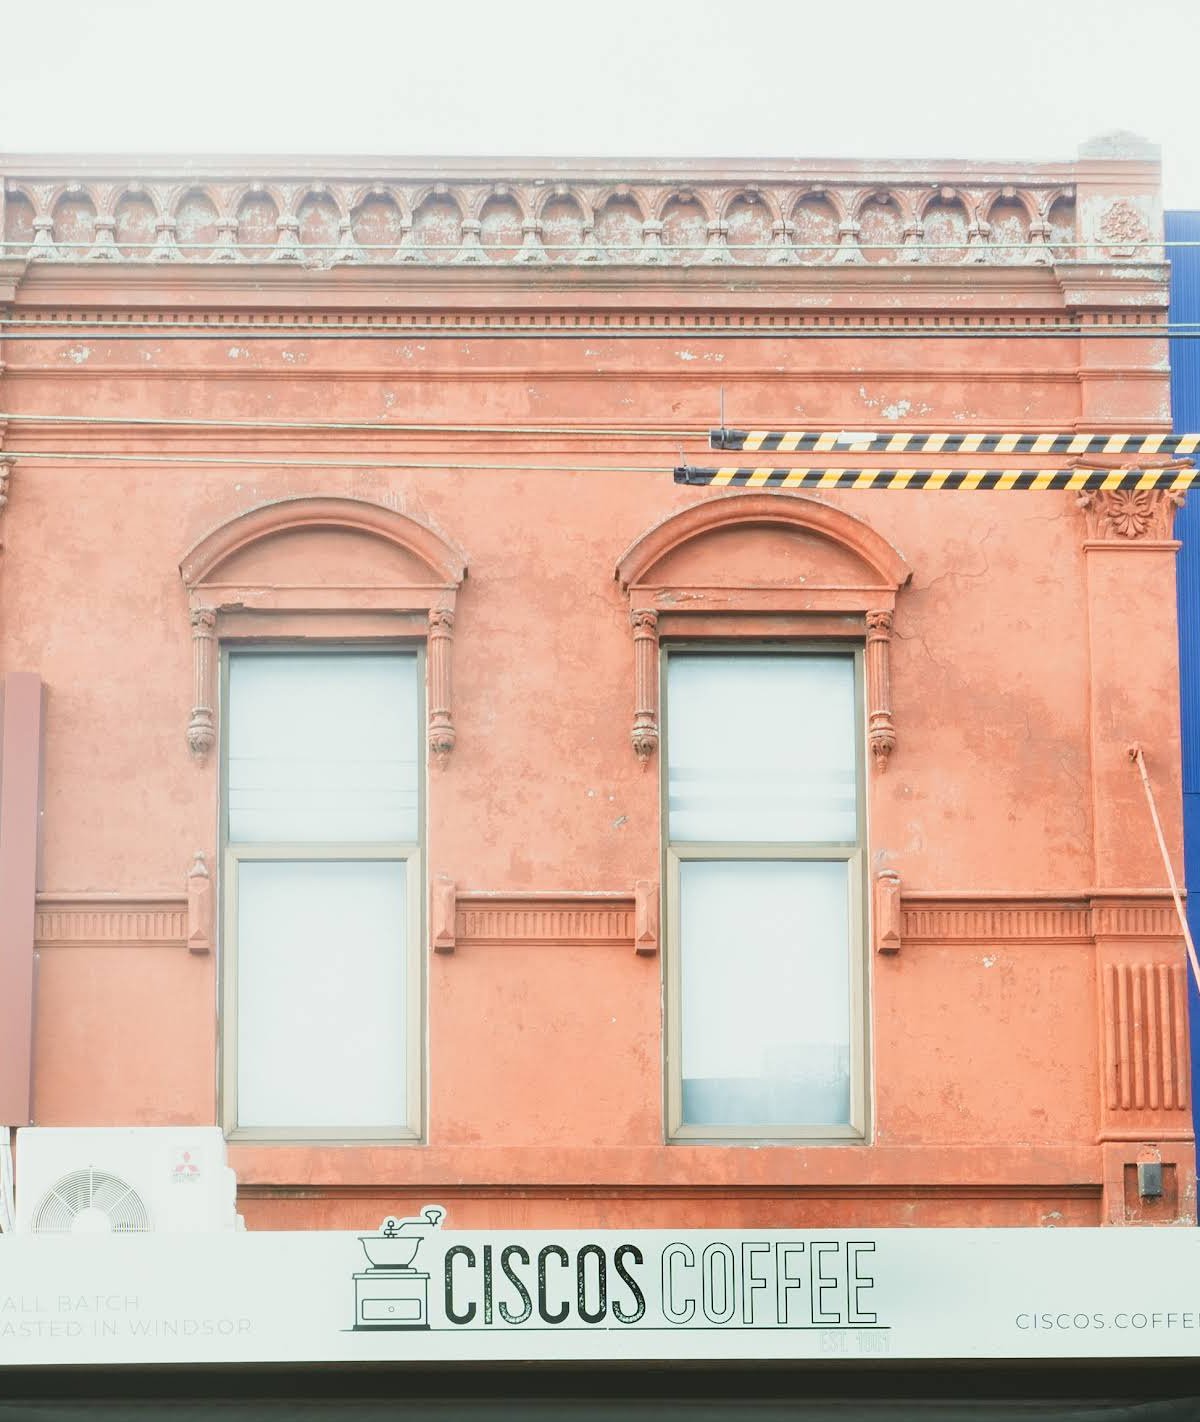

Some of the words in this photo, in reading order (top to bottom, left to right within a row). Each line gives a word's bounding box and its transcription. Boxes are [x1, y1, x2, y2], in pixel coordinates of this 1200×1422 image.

[444, 1244, 646, 1325] CISCOS
[661, 1241, 878, 1325] COFFEE
[57, 1295, 140, 1312] BATCH
[94, 1319, 117, 1336] IN
[129, 1318, 254, 1336] WINDSOR
[1015, 1313, 1200, 1330] CISCOS.COFFE
